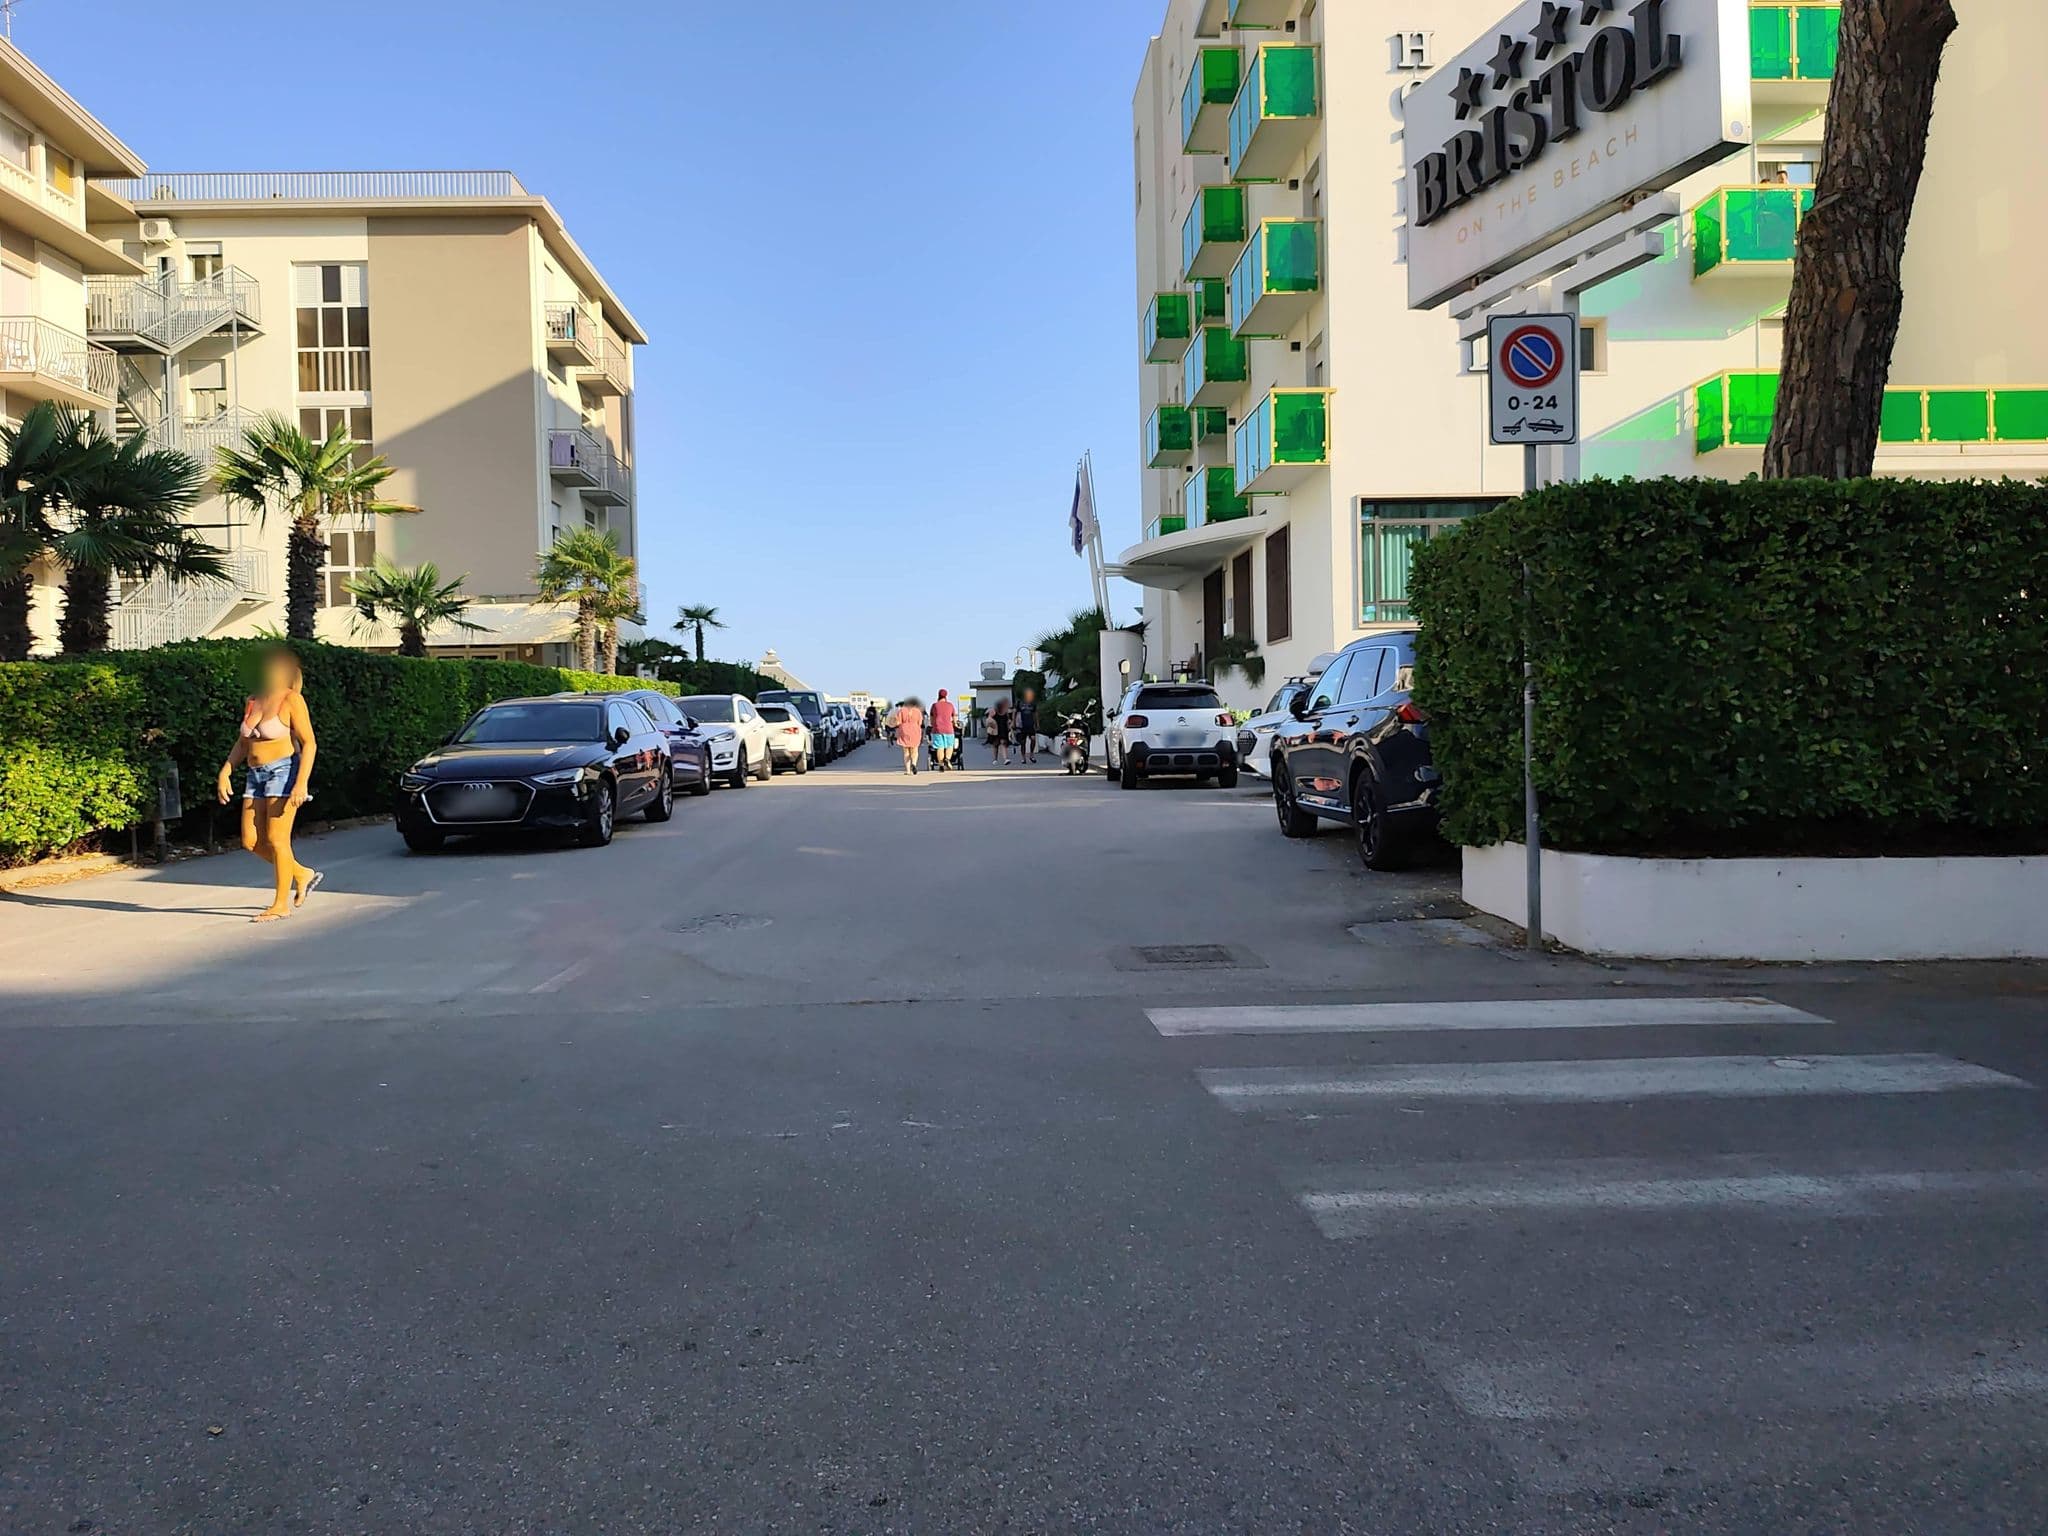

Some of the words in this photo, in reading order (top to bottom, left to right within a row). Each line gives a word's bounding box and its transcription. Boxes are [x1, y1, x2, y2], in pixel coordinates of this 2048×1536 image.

[1413, 0, 1681, 228] BRISTOL
[1457, 217, 1483, 243] ON
[1496, 184, 1537, 219] THE
[1553, 124, 1638, 189] BEACH
